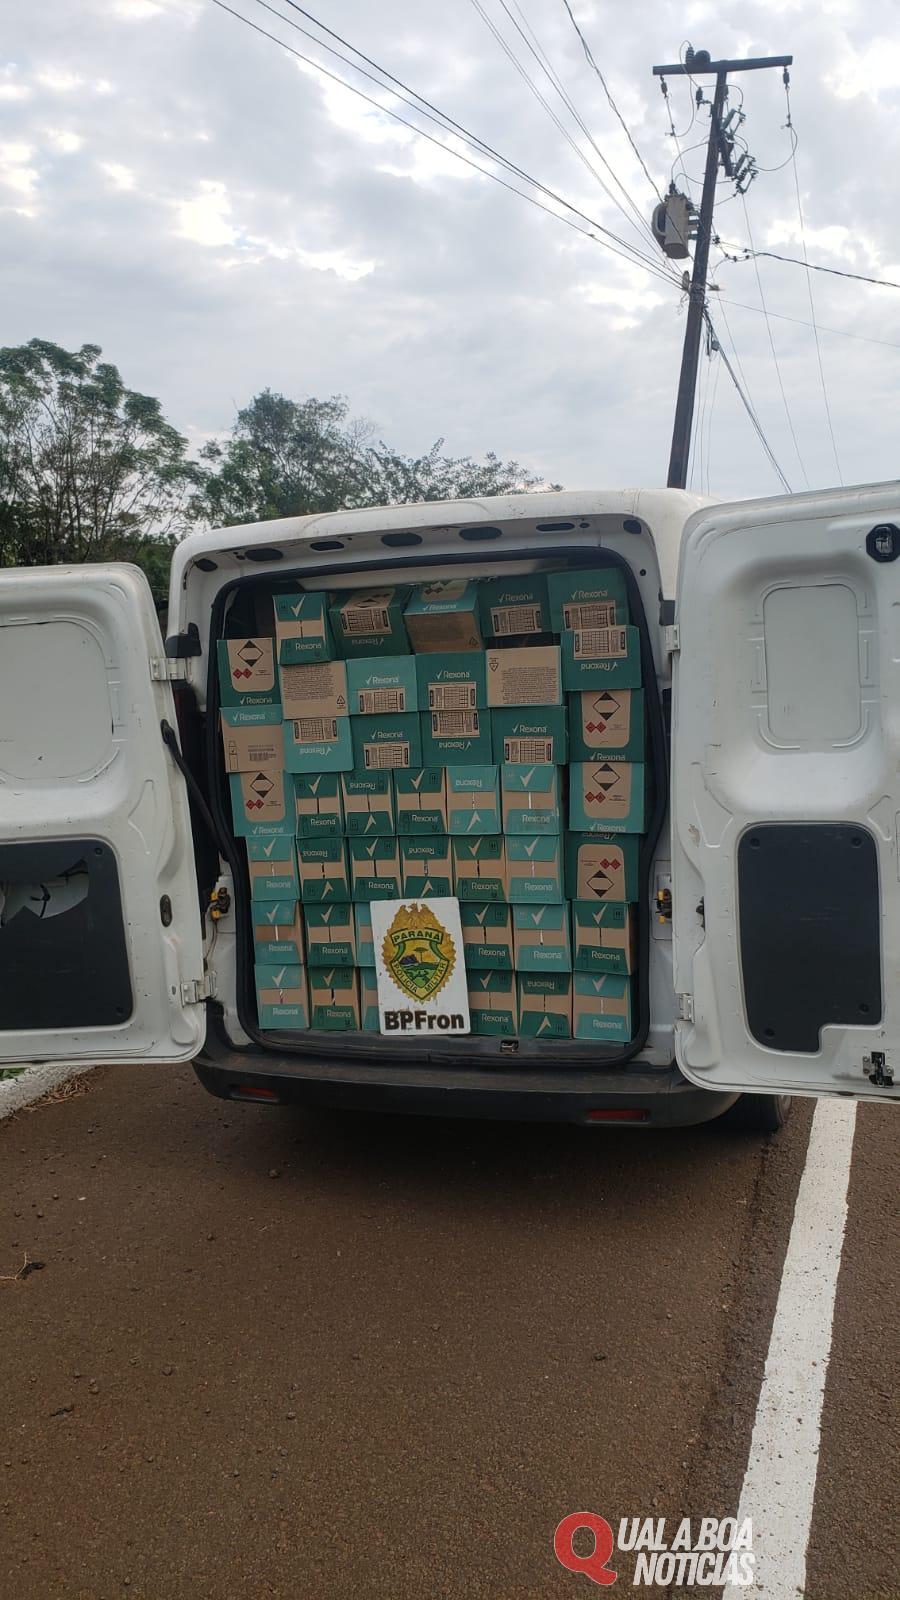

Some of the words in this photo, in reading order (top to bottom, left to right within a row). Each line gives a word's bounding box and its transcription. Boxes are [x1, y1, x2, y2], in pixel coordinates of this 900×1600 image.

[505, 593, 534, 602] Rexona
[578, 589, 609, 599] Rexona
[429, 603, 458, 611] Rexona
[351, 637, 379, 646] Rexona
[295, 642, 322, 651] Rexona
[580, 662, 610, 671] Rexona
[443, 670, 471, 679] Rexona
[371, 675, 400, 685] Rexona
[246, 696, 273, 705] Rexona
[239, 712, 266, 721] Rexona
[519, 724, 547, 733] Rexona
[377, 731, 404, 739] Rexona
[438, 741, 465, 749] Rexona
[299, 747, 325, 756] Rexona
[596, 752, 626, 761] Rexona
[350, 782, 376, 790] Rexona
[455, 779, 482, 787] Rexona
[310, 818, 337, 826] Rexona
[412, 814, 439, 823] Rexona
[522, 814, 550, 823] Rexona
[258, 826, 284, 834] Rexona
[596, 823, 626, 832] Rexona
[303, 850, 328, 858] Rexona
[408, 847, 435, 855] Rexona
[266, 880, 291, 889] Rexona
[368, 882, 394, 890] Rexona
[471, 882, 499, 890] Rexona
[525, 883, 553, 891] Rexona
[268, 943, 292, 952] Rexona
[322, 946, 348, 954] Rexona
[478, 948, 506, 957] Rexona
[533, 950, 562, 959] Rexona
[591, 951, 620, 961] Rexona
[527, 980, 555, 990] Rexona
[272, 1007, 299, 1016] Rexona
[326, 1009, 352, 1018] Rexona
[384, 1010, 465, 1031] BPFron
[481, 1013, 509, 1023] Rexona
[592, 1019, 623, 1030] Rexona
